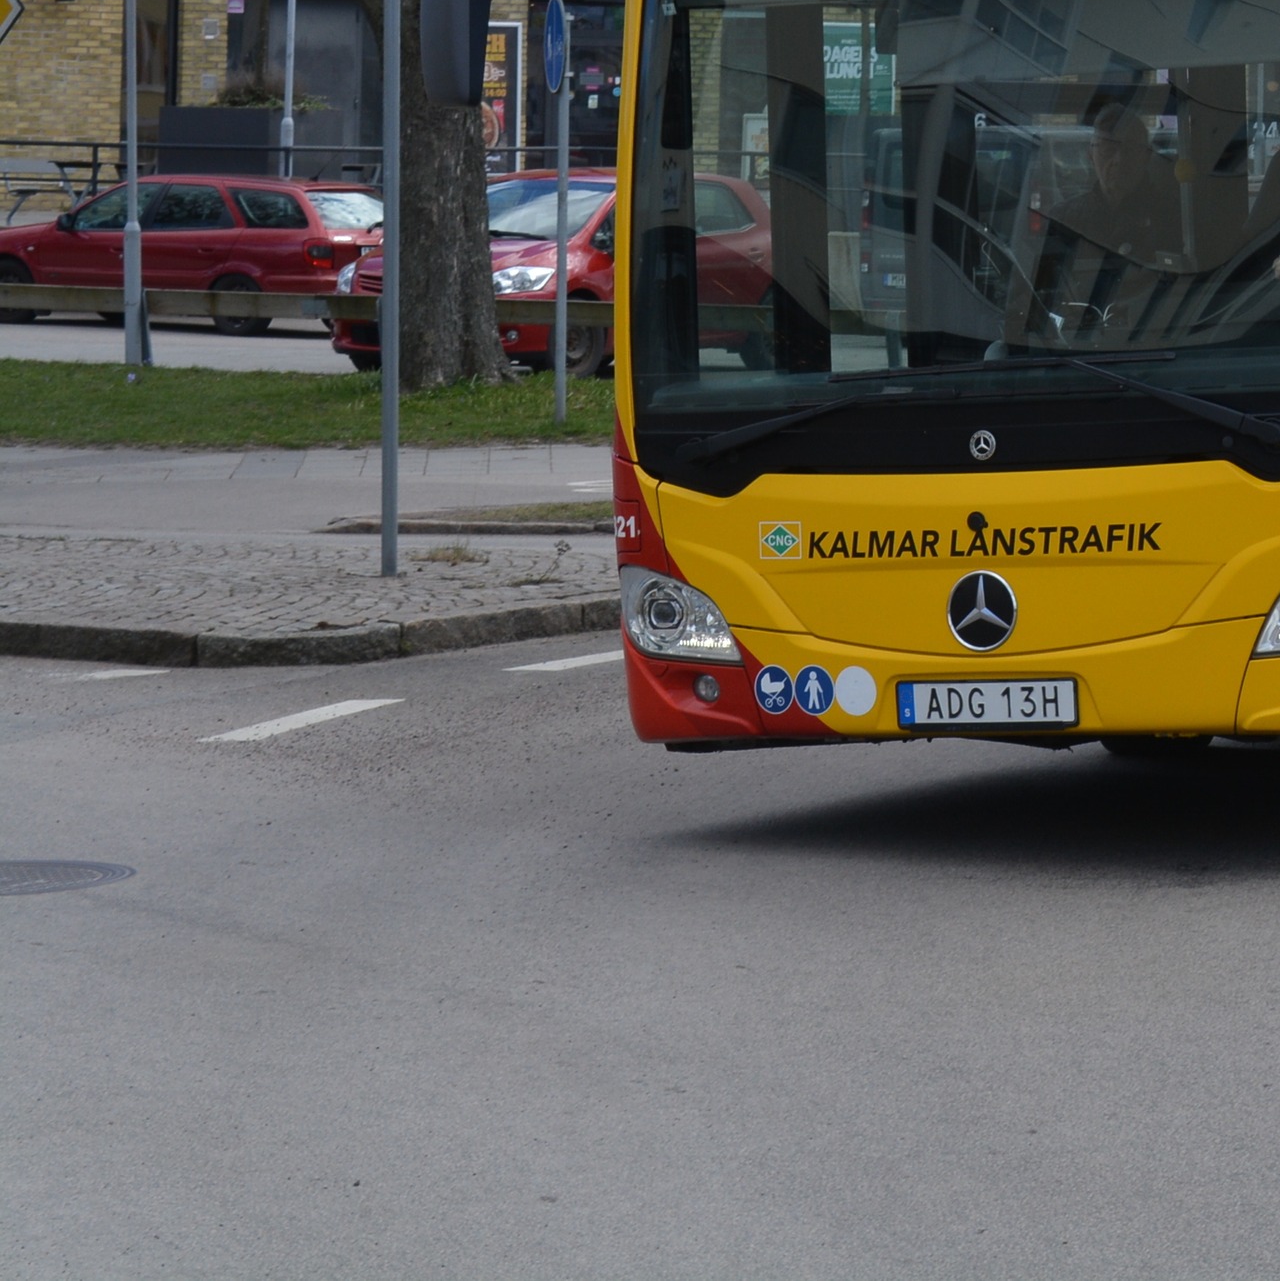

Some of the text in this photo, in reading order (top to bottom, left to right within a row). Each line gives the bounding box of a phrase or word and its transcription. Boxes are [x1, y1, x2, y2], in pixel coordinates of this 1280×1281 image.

[615, 515, 636, 538] 21
[768, 534, 793, 547] CNG
[808, 530, 940, 559] KALMAR
[903, 708, 911, 718] S
[927, 685, 1060, 720] ADG 13H
